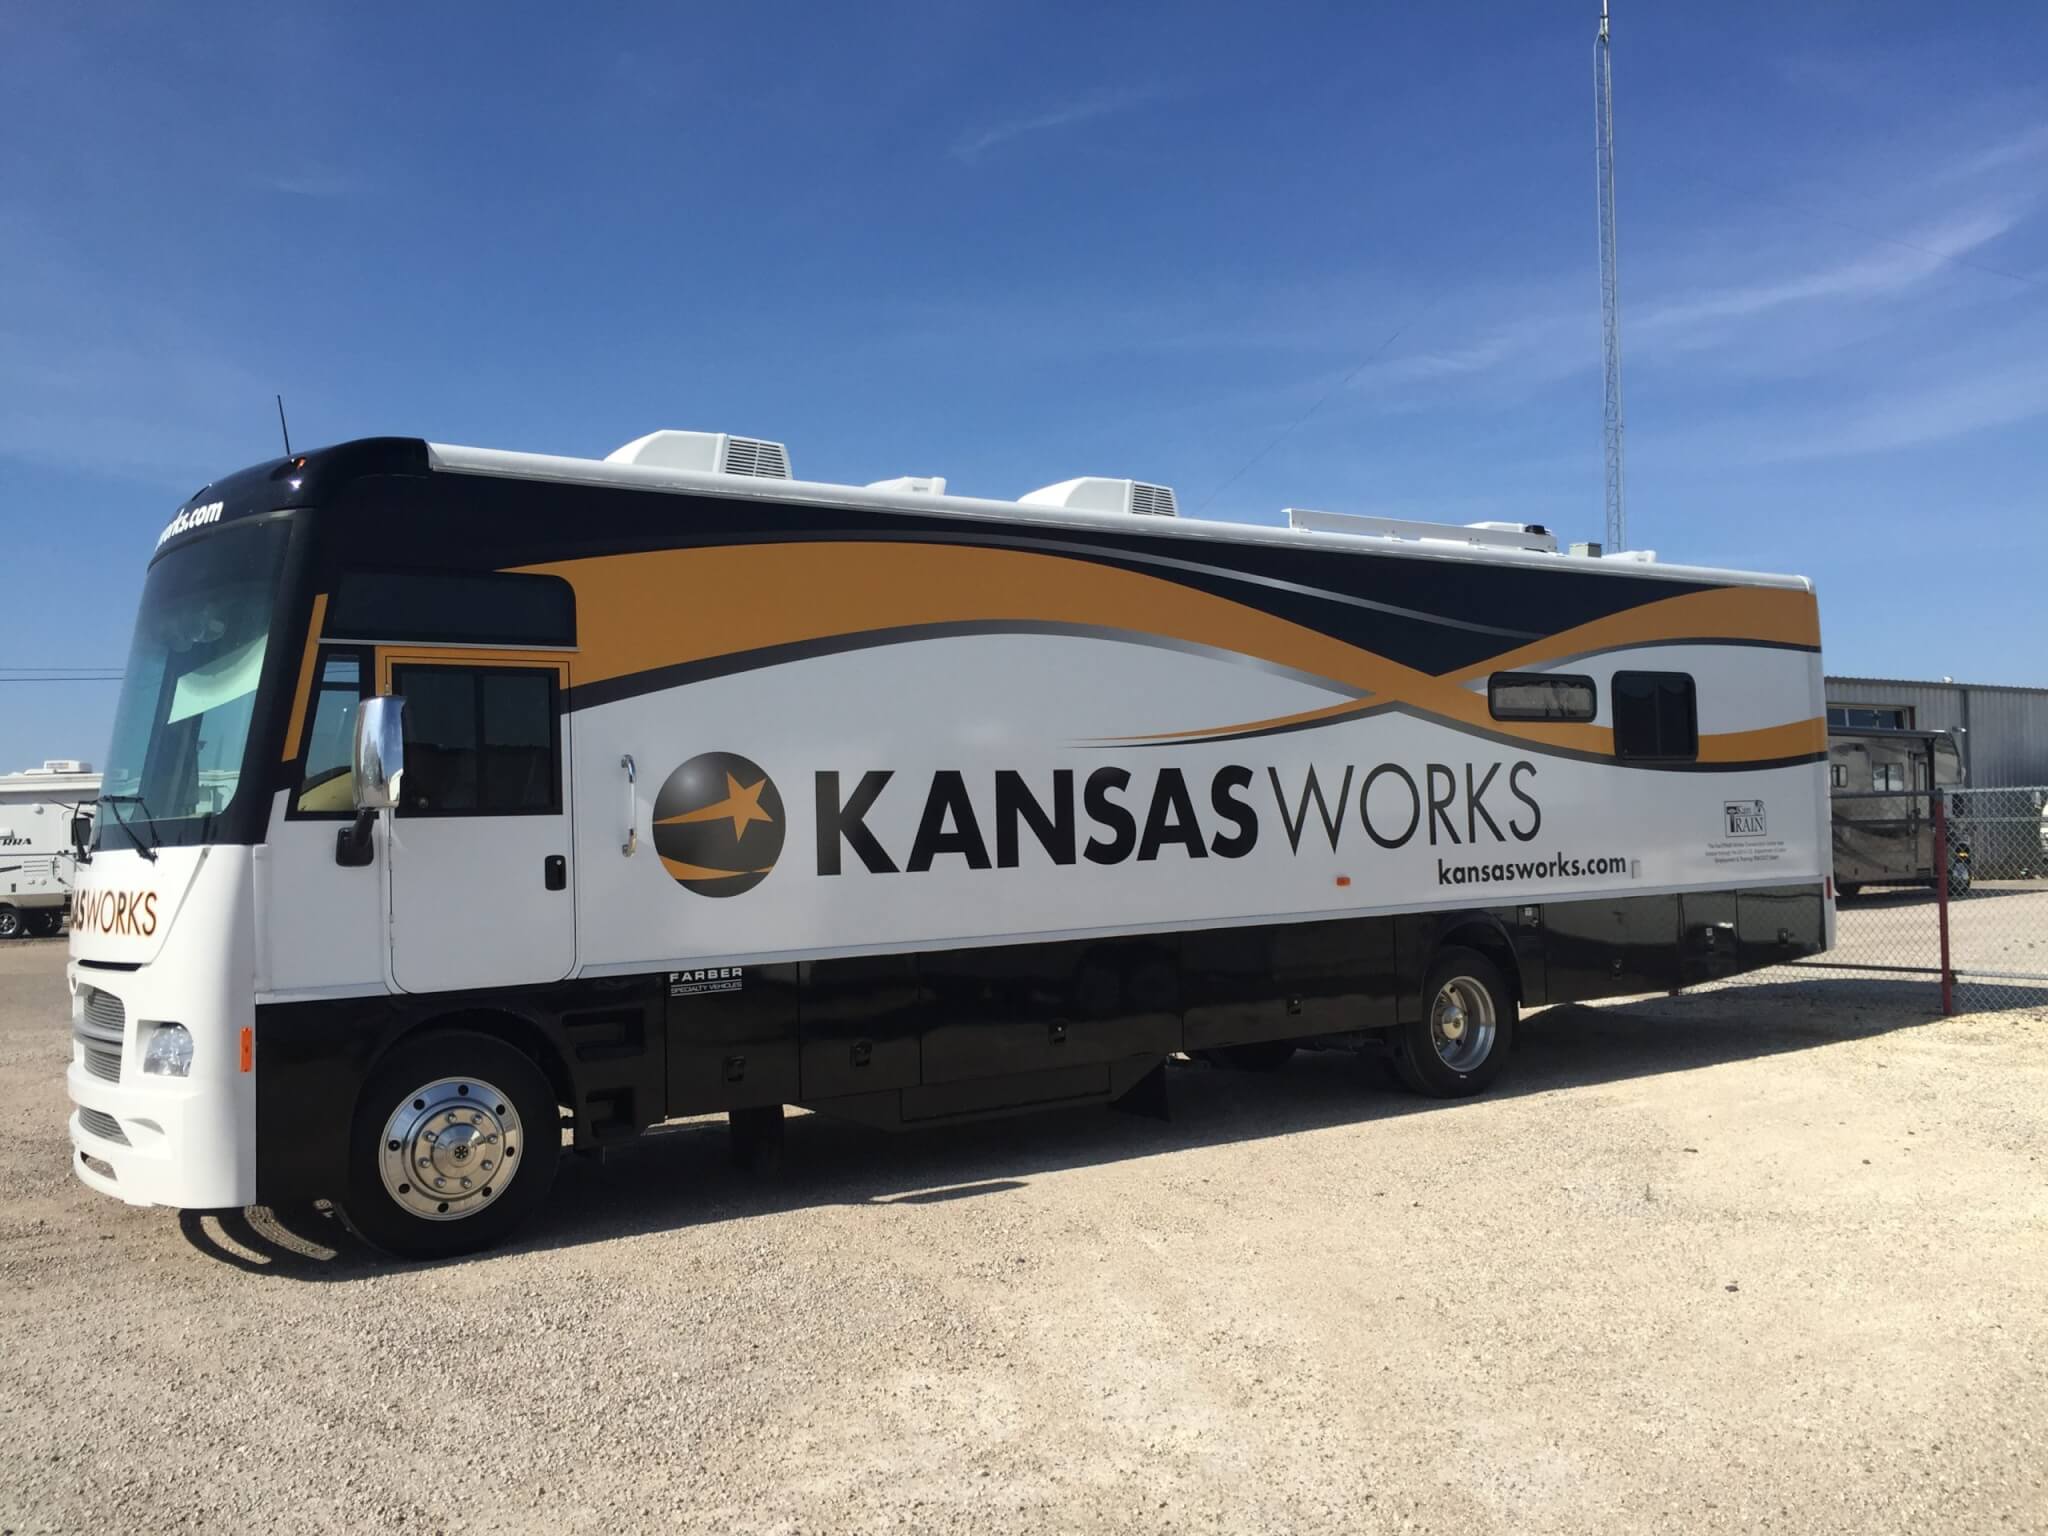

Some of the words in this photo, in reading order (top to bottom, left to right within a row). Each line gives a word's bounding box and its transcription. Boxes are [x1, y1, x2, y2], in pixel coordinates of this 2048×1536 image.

[1437, 852, 1627, 885] kansasworks.com
[669, 968, 743, 983] FARBER
[708, 981, 743, 990] VEHICLES
